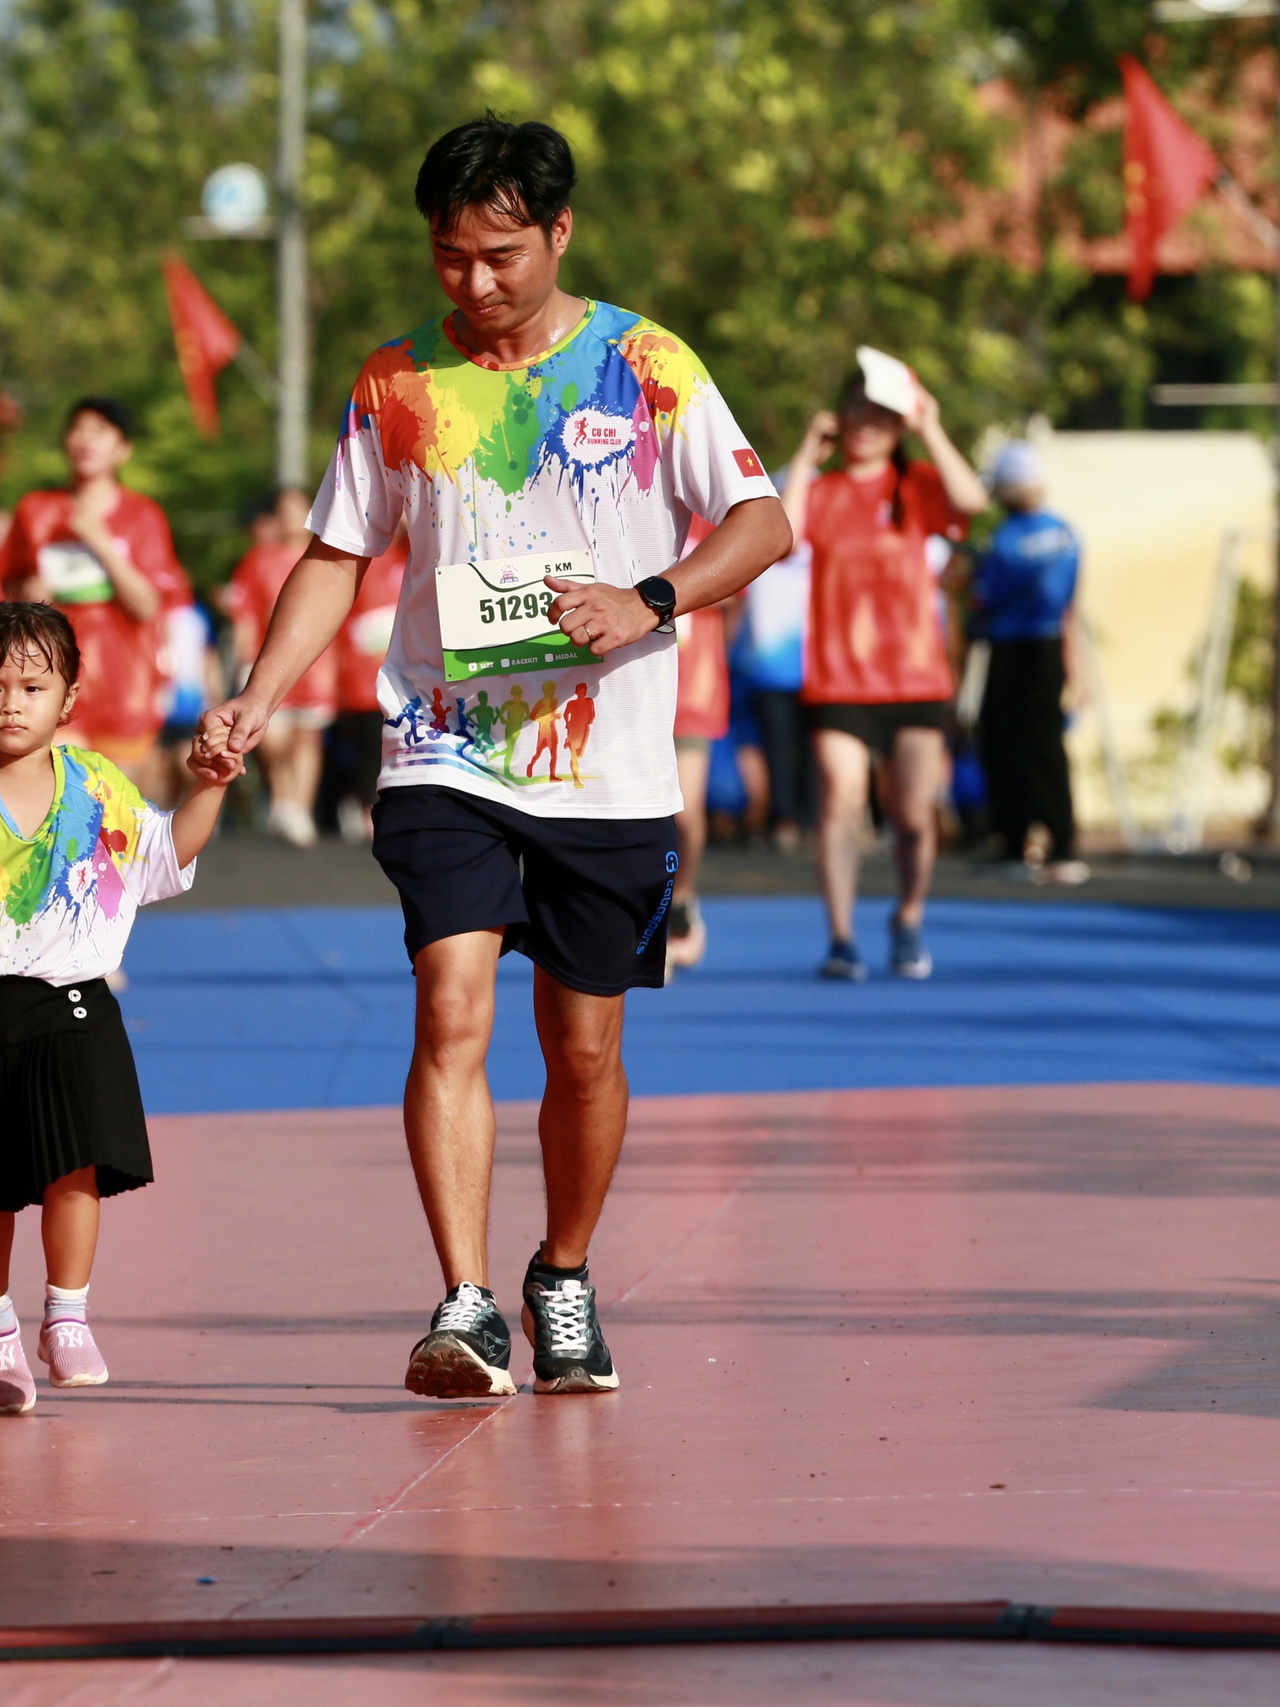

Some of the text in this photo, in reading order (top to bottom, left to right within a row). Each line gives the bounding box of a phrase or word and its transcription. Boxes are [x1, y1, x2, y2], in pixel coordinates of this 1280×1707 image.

[591, 427, 616, 438] CU CHI
[544, 562, 573, 574] 5 KM
[479, 591, 553, 624] 51293
[511, 657, 538, 666] RACEKIT
[555, 652, 577, 661] MEDAL
